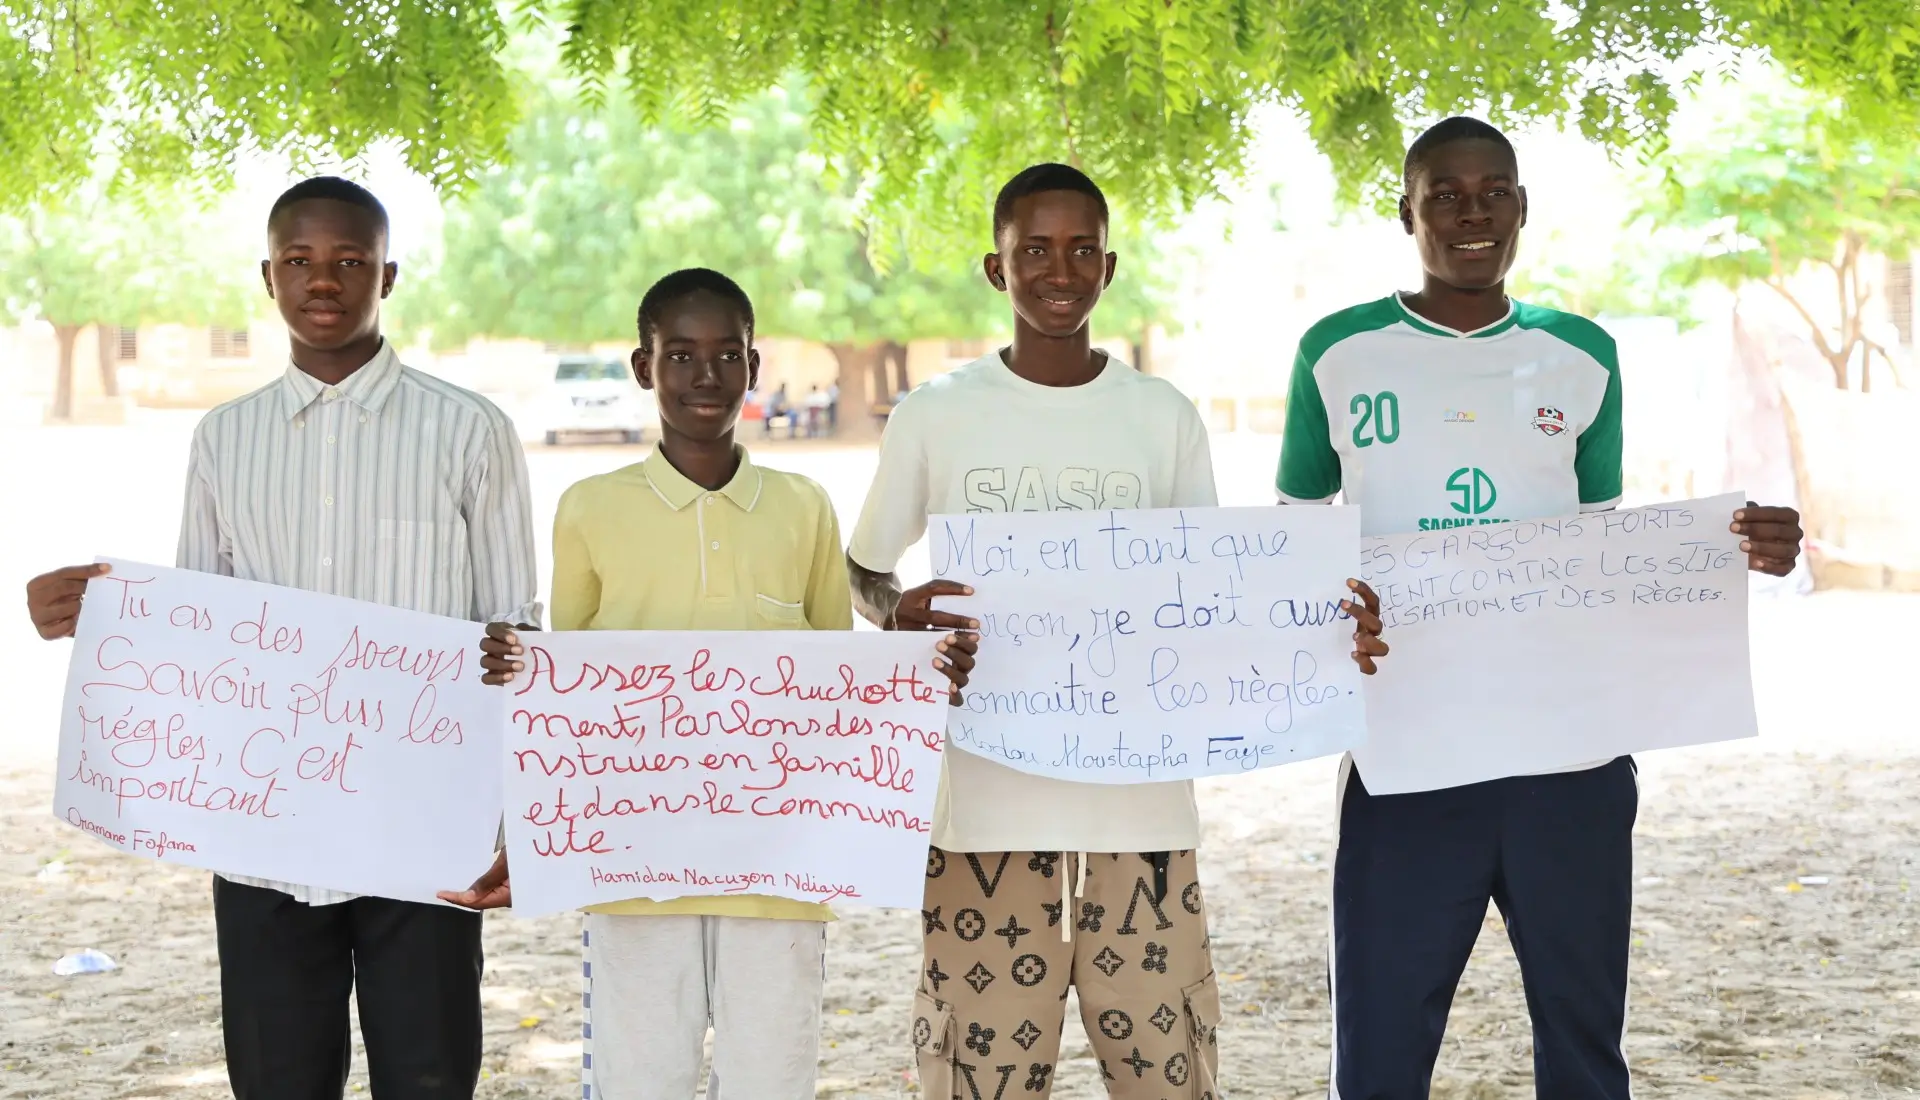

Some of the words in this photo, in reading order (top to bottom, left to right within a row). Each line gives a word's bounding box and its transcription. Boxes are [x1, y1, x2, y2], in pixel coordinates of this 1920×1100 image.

[1350, 391, 1399, 448] 20
[937, 518, 1029, 577] Moi,
[1039, 538, 1088, 571] en
[1099, 510, 1200, 570] tant
[1211, 530, 1290, 582] que
[1361, 545, 1396, 580] ES
[1592, 508, 1694, 536] FORTS
[977, 612, 1081, 652] rçon,
[1154, 572, 1252, 630] doit
[1375, 575, 1444, 608] TENT
[1450, 558, 1583, 595] CONTRE
[1554, 584, 1616, 608] DES
[105, 576, 156, 620] Tu
[169, 604, 212, 632] as
[230, 601, 303, 654] des
[82, 635, 271, 709] Savoir
[288, 666, 384, 737] plus
[398, 683, 463, 746] les
[514, 646, 676, 706] Assez
[685, 648, 746, 692] les
[962, 663, 1118, 715] onnaitre
[1147, 647, 1207, 713] les
[826, 708, 873, 737] des
[698, 750, 757, 774] en
[741, 742, 914, 793] famille
[523, 787, 580, 826] et
[584, 786, 701, 819] dans
[703, 781, 744, 814] le
[133, 829, 196, 857] Fofana
